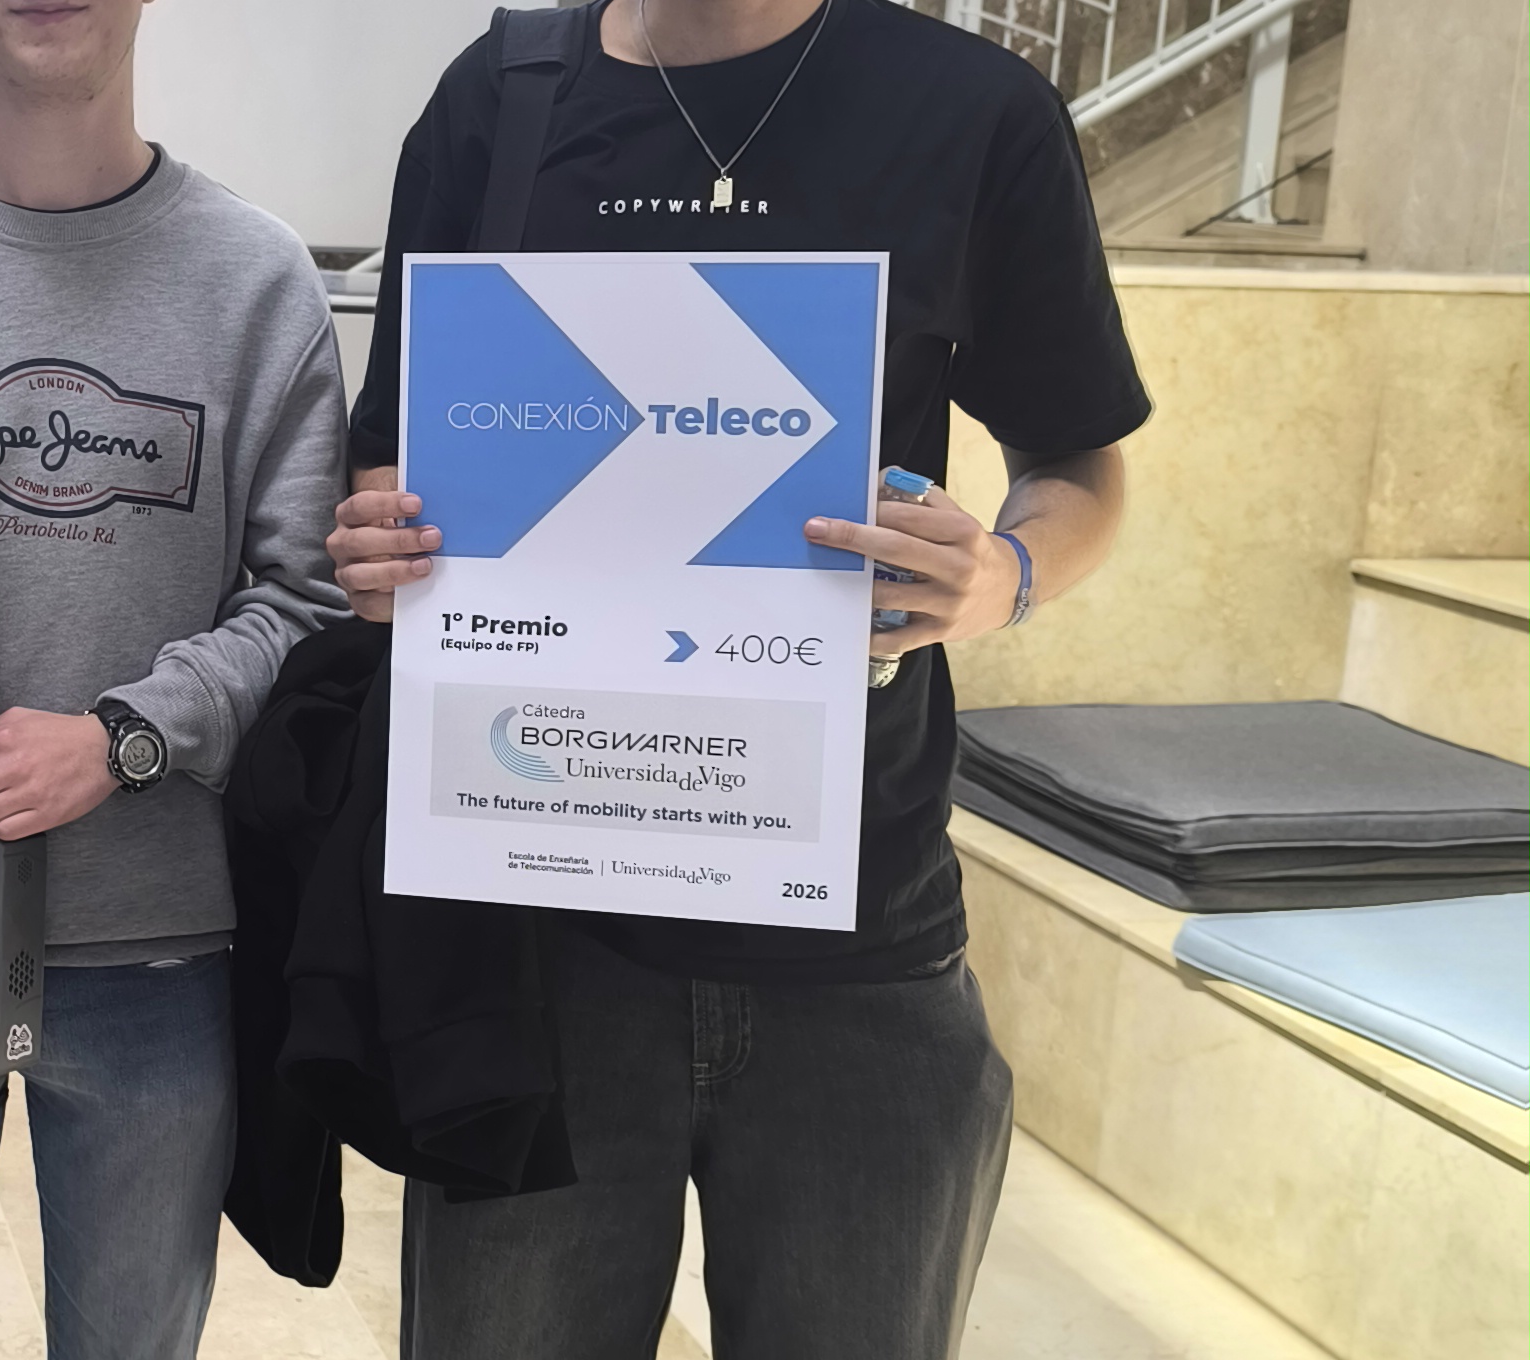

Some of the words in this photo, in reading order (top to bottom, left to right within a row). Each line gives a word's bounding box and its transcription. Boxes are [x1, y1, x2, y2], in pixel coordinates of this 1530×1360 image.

[598, 198, 768, 215] COPYWRIER
[28, 378, 85, 395] LONDON
[447, 396, 628, 433] CONEXIÓN
[647, 398, 812, 438] Teleco
[40, 410, 163, 472] Jeans
[14, 476, 50, 498] DENIM
[52, 481, 93, 498] BRAND
[131, 505, 152, 516] 1973
[93, 527, 118, 545] Rd.
[471, 614, 568, 637] Premio
[441, 638, 492, 652] (Equipo
[496, 640, 513, 651] de
[517, 641, 539, 655] FP)
[714, 632, 824, 666] 400€
[522, 704, 585, 720] Cátedra
[521, 726, 748, 758] BORGWARNER
[457, 792, 488, 808] The
[493, 795, 545, 812] future
[550, 799, 569, 813] of
[574, 801, 647, 821] mobility
[652, 807, 702, 824] starts
[708, 810, 747, 826] with
[753, 815, 791, 830] you.
[508, 851, 535, 861] Escola
[537, 853, 547, 862] de
[508, 860, 518, 869] de
[781, 882, 828, 900] 2026
